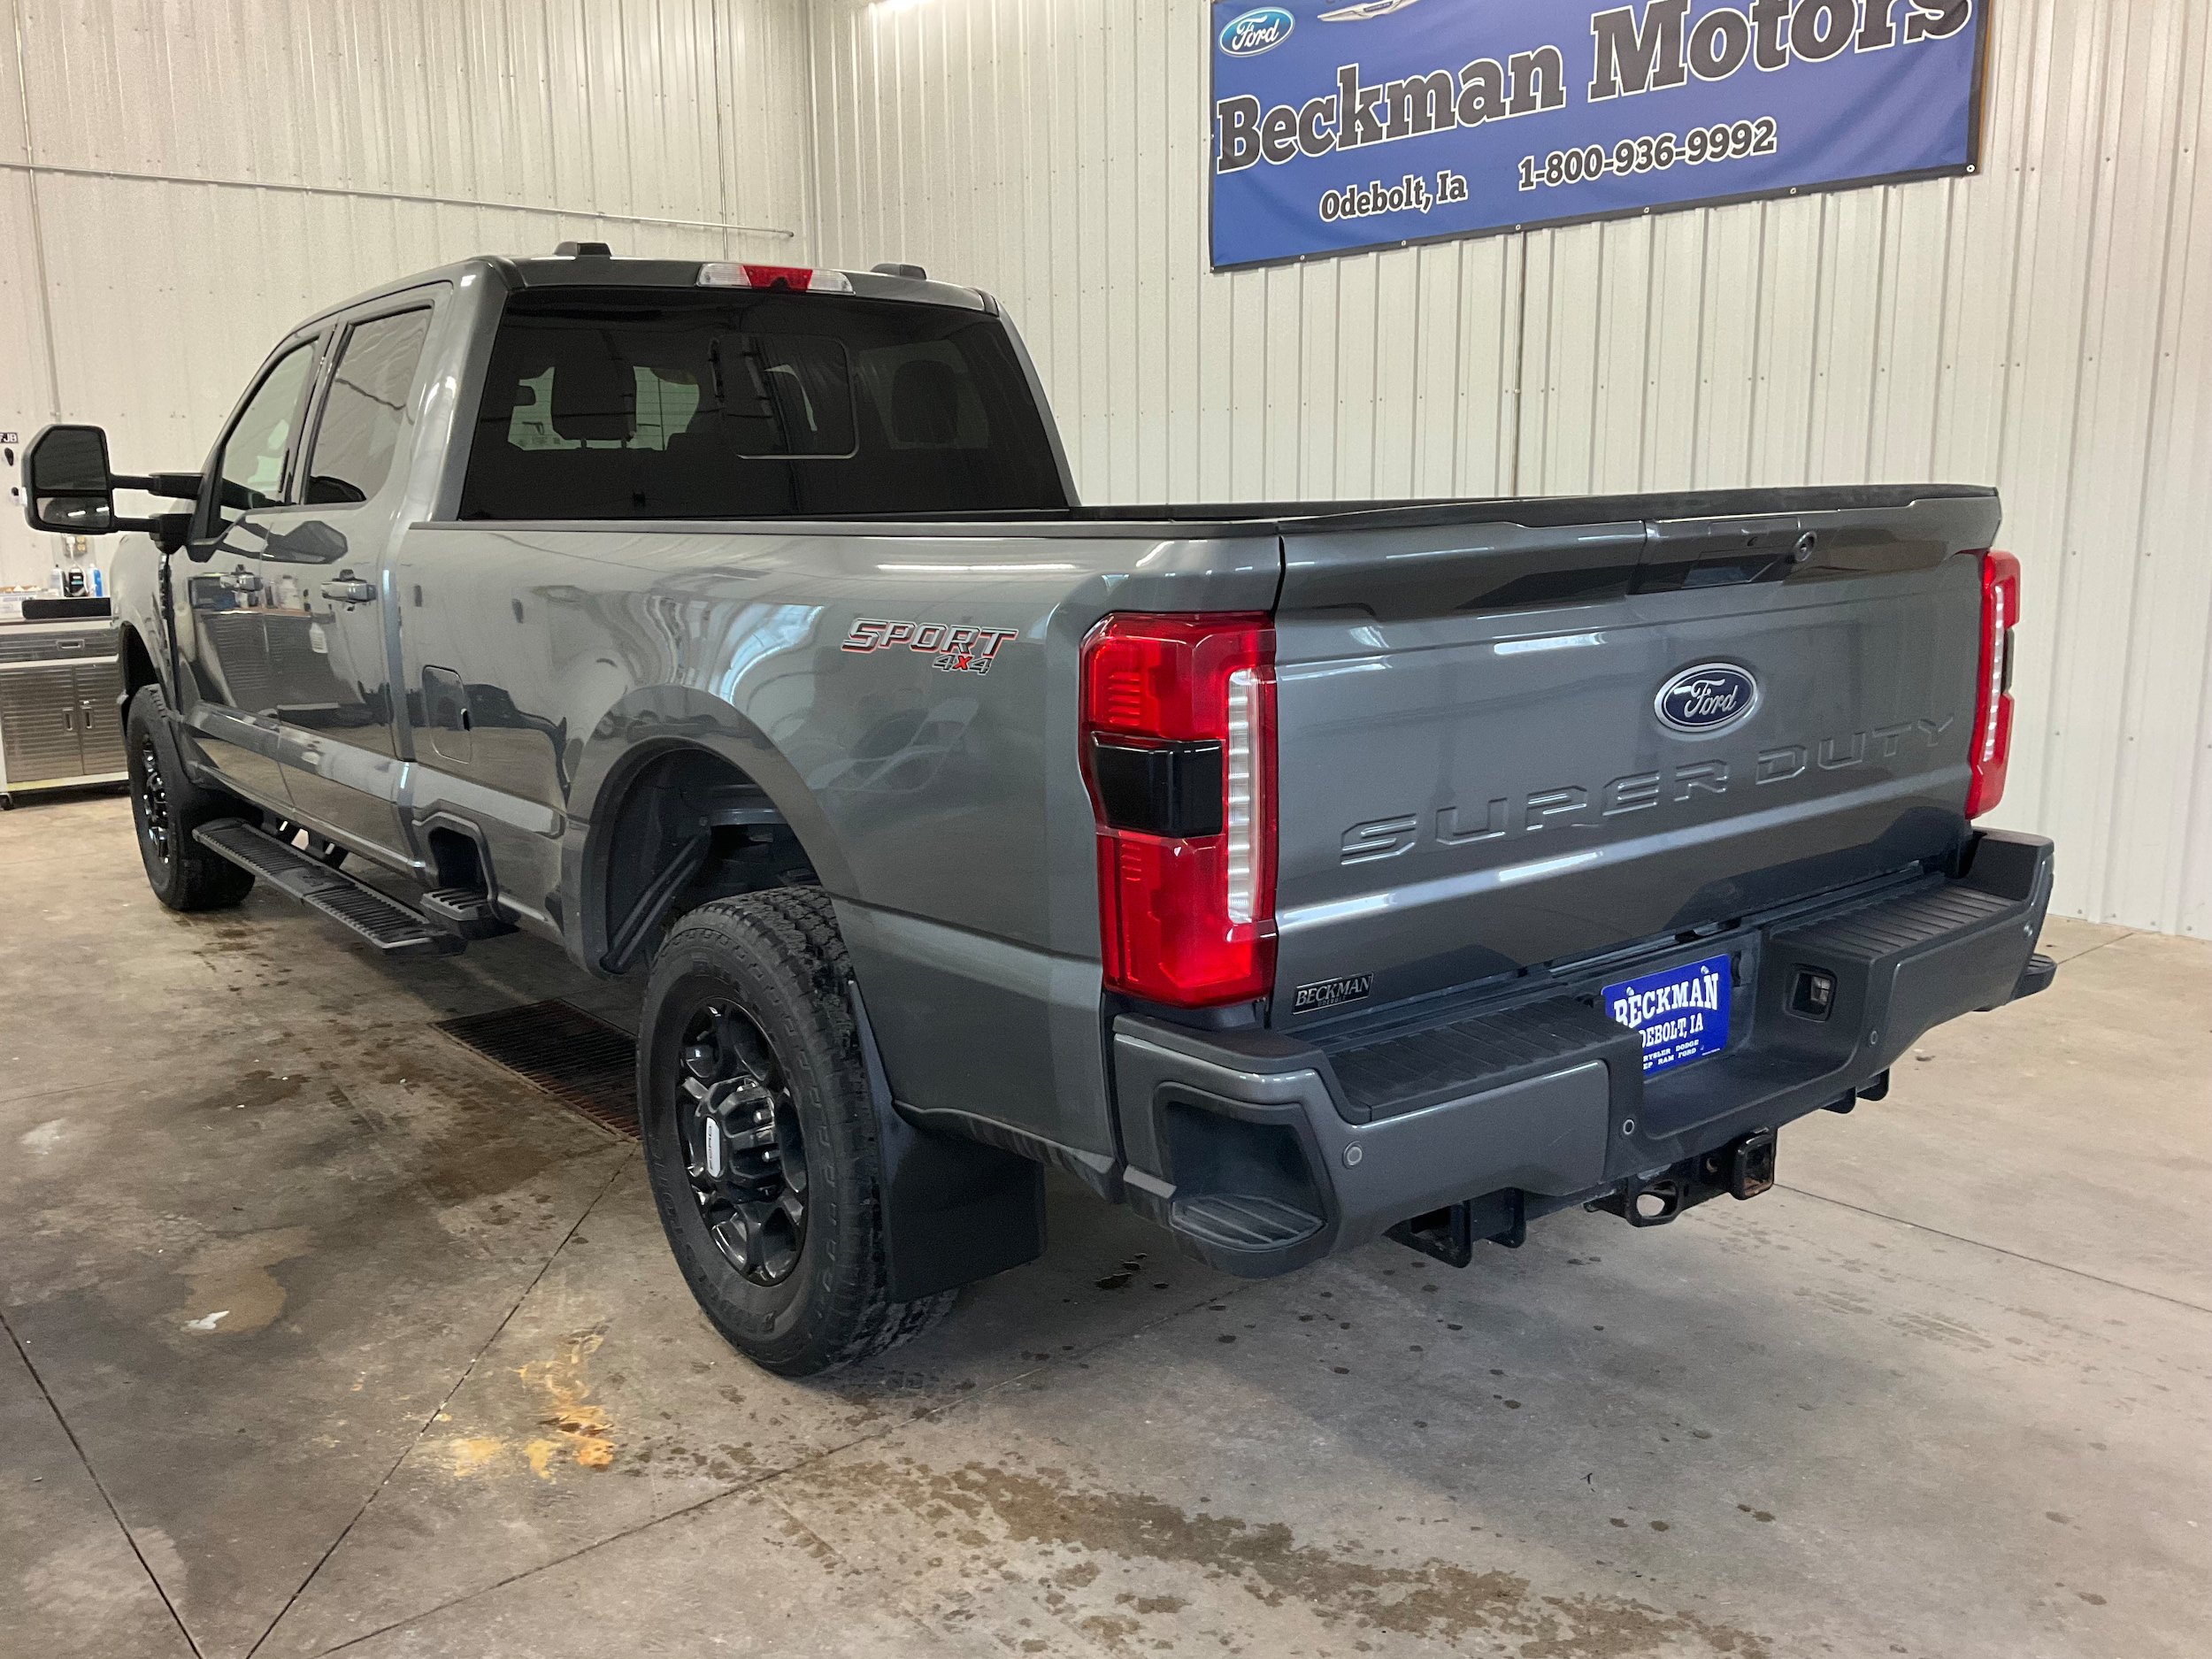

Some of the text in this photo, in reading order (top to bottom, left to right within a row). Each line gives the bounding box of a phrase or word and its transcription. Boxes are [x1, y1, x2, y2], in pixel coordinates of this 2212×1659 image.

[1232, 16, 1281, 50] Ford
[1217, 45, 1566, 174] Beckman
[1518, 116, 1777, 191] 1-800-936-9992
[1319, 170, 1468, 222] Odebolt, Ia
[841, 618, 1019, 658] SPORT
[1684, 678, 1739, 718] Ford
[1340, 712, 1955, 865] SUPER DUTY
[1294, 976, 1371, 1007] BECKMAN
[1689, 1012, 1704, 1034] IA
[1657, 1054, 1675, 1065] RAM
[1678, 1047, 1697, 1059] FORD
[1675, 1039, 1700, 1052] DODGE
